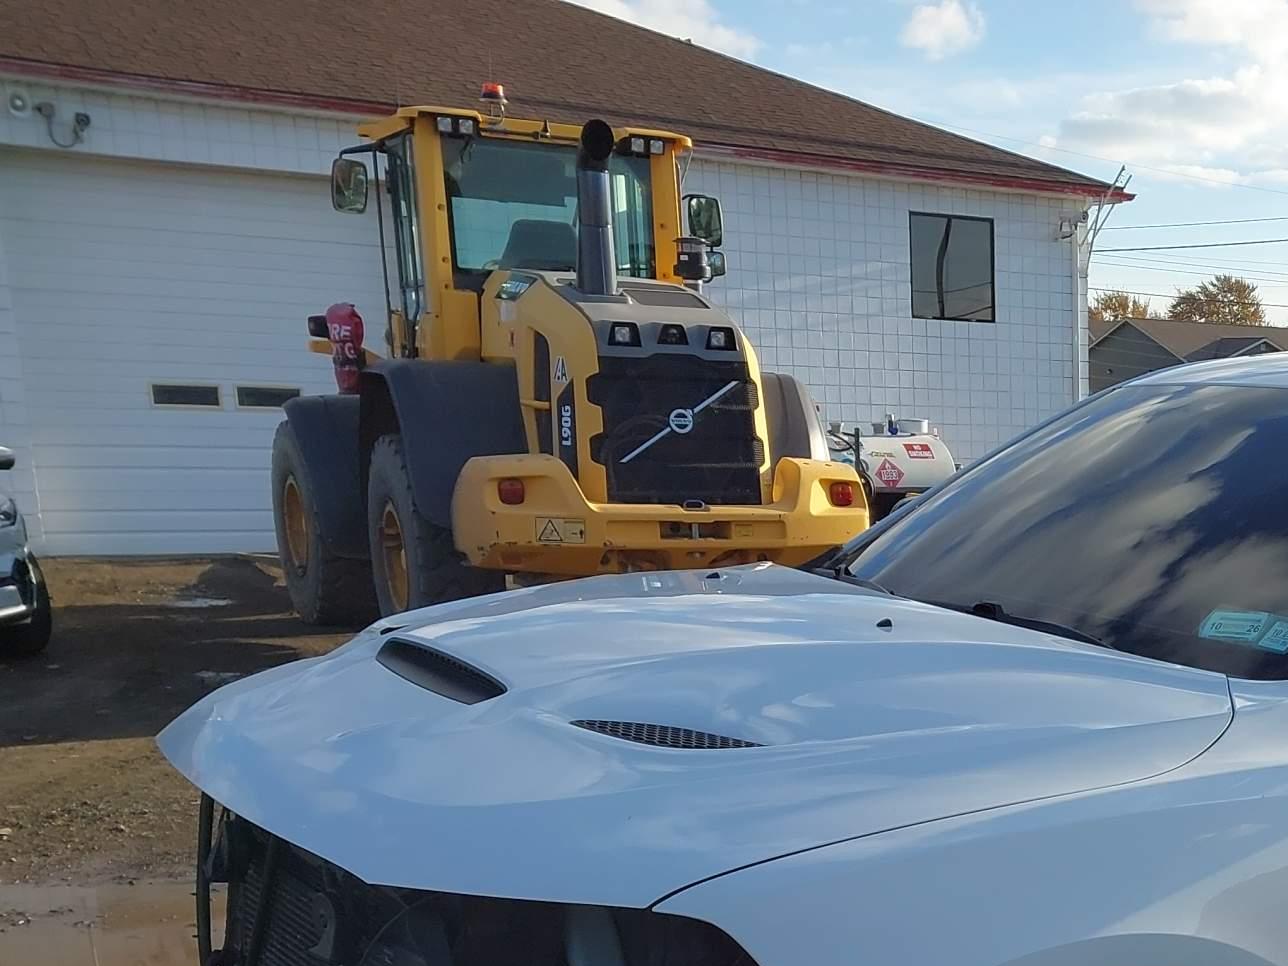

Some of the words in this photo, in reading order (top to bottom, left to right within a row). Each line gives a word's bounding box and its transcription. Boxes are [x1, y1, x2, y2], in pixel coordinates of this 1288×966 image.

[561, 405, 572, 446] L90G
[1210, 622, 1222, 630] 10
[1246, 624, 1261, 633] 26
